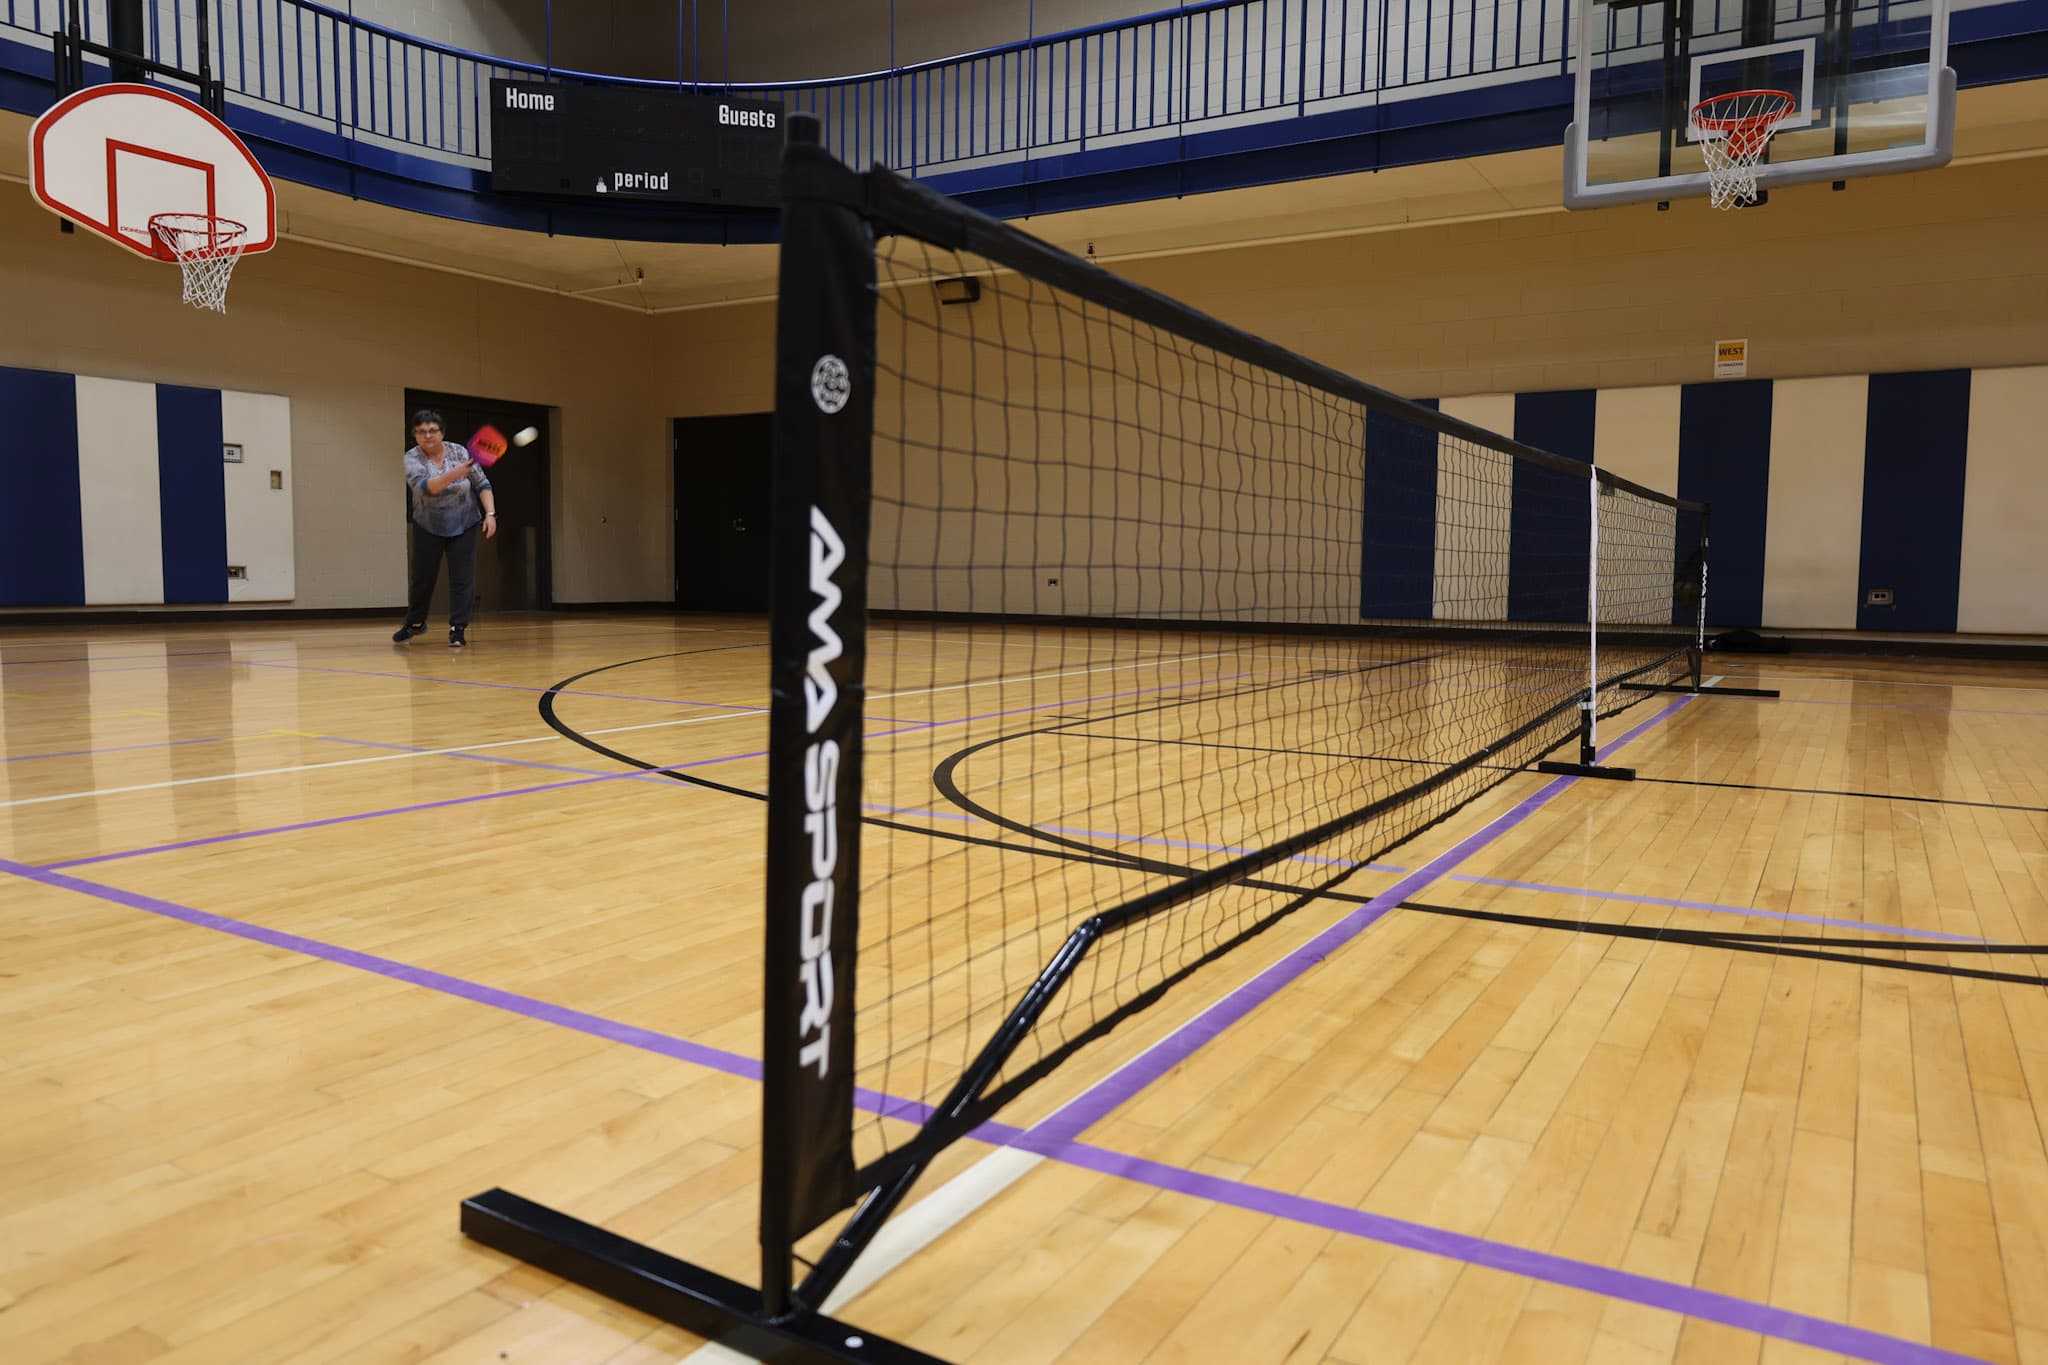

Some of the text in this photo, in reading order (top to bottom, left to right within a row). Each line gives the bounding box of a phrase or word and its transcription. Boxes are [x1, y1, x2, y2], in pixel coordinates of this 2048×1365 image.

[506, 87, 554, 111] Home
[718, 104, 776, 128] Guests
[614, 172, 669, 190] period
[1719, 347, 1744, 356] WEST
